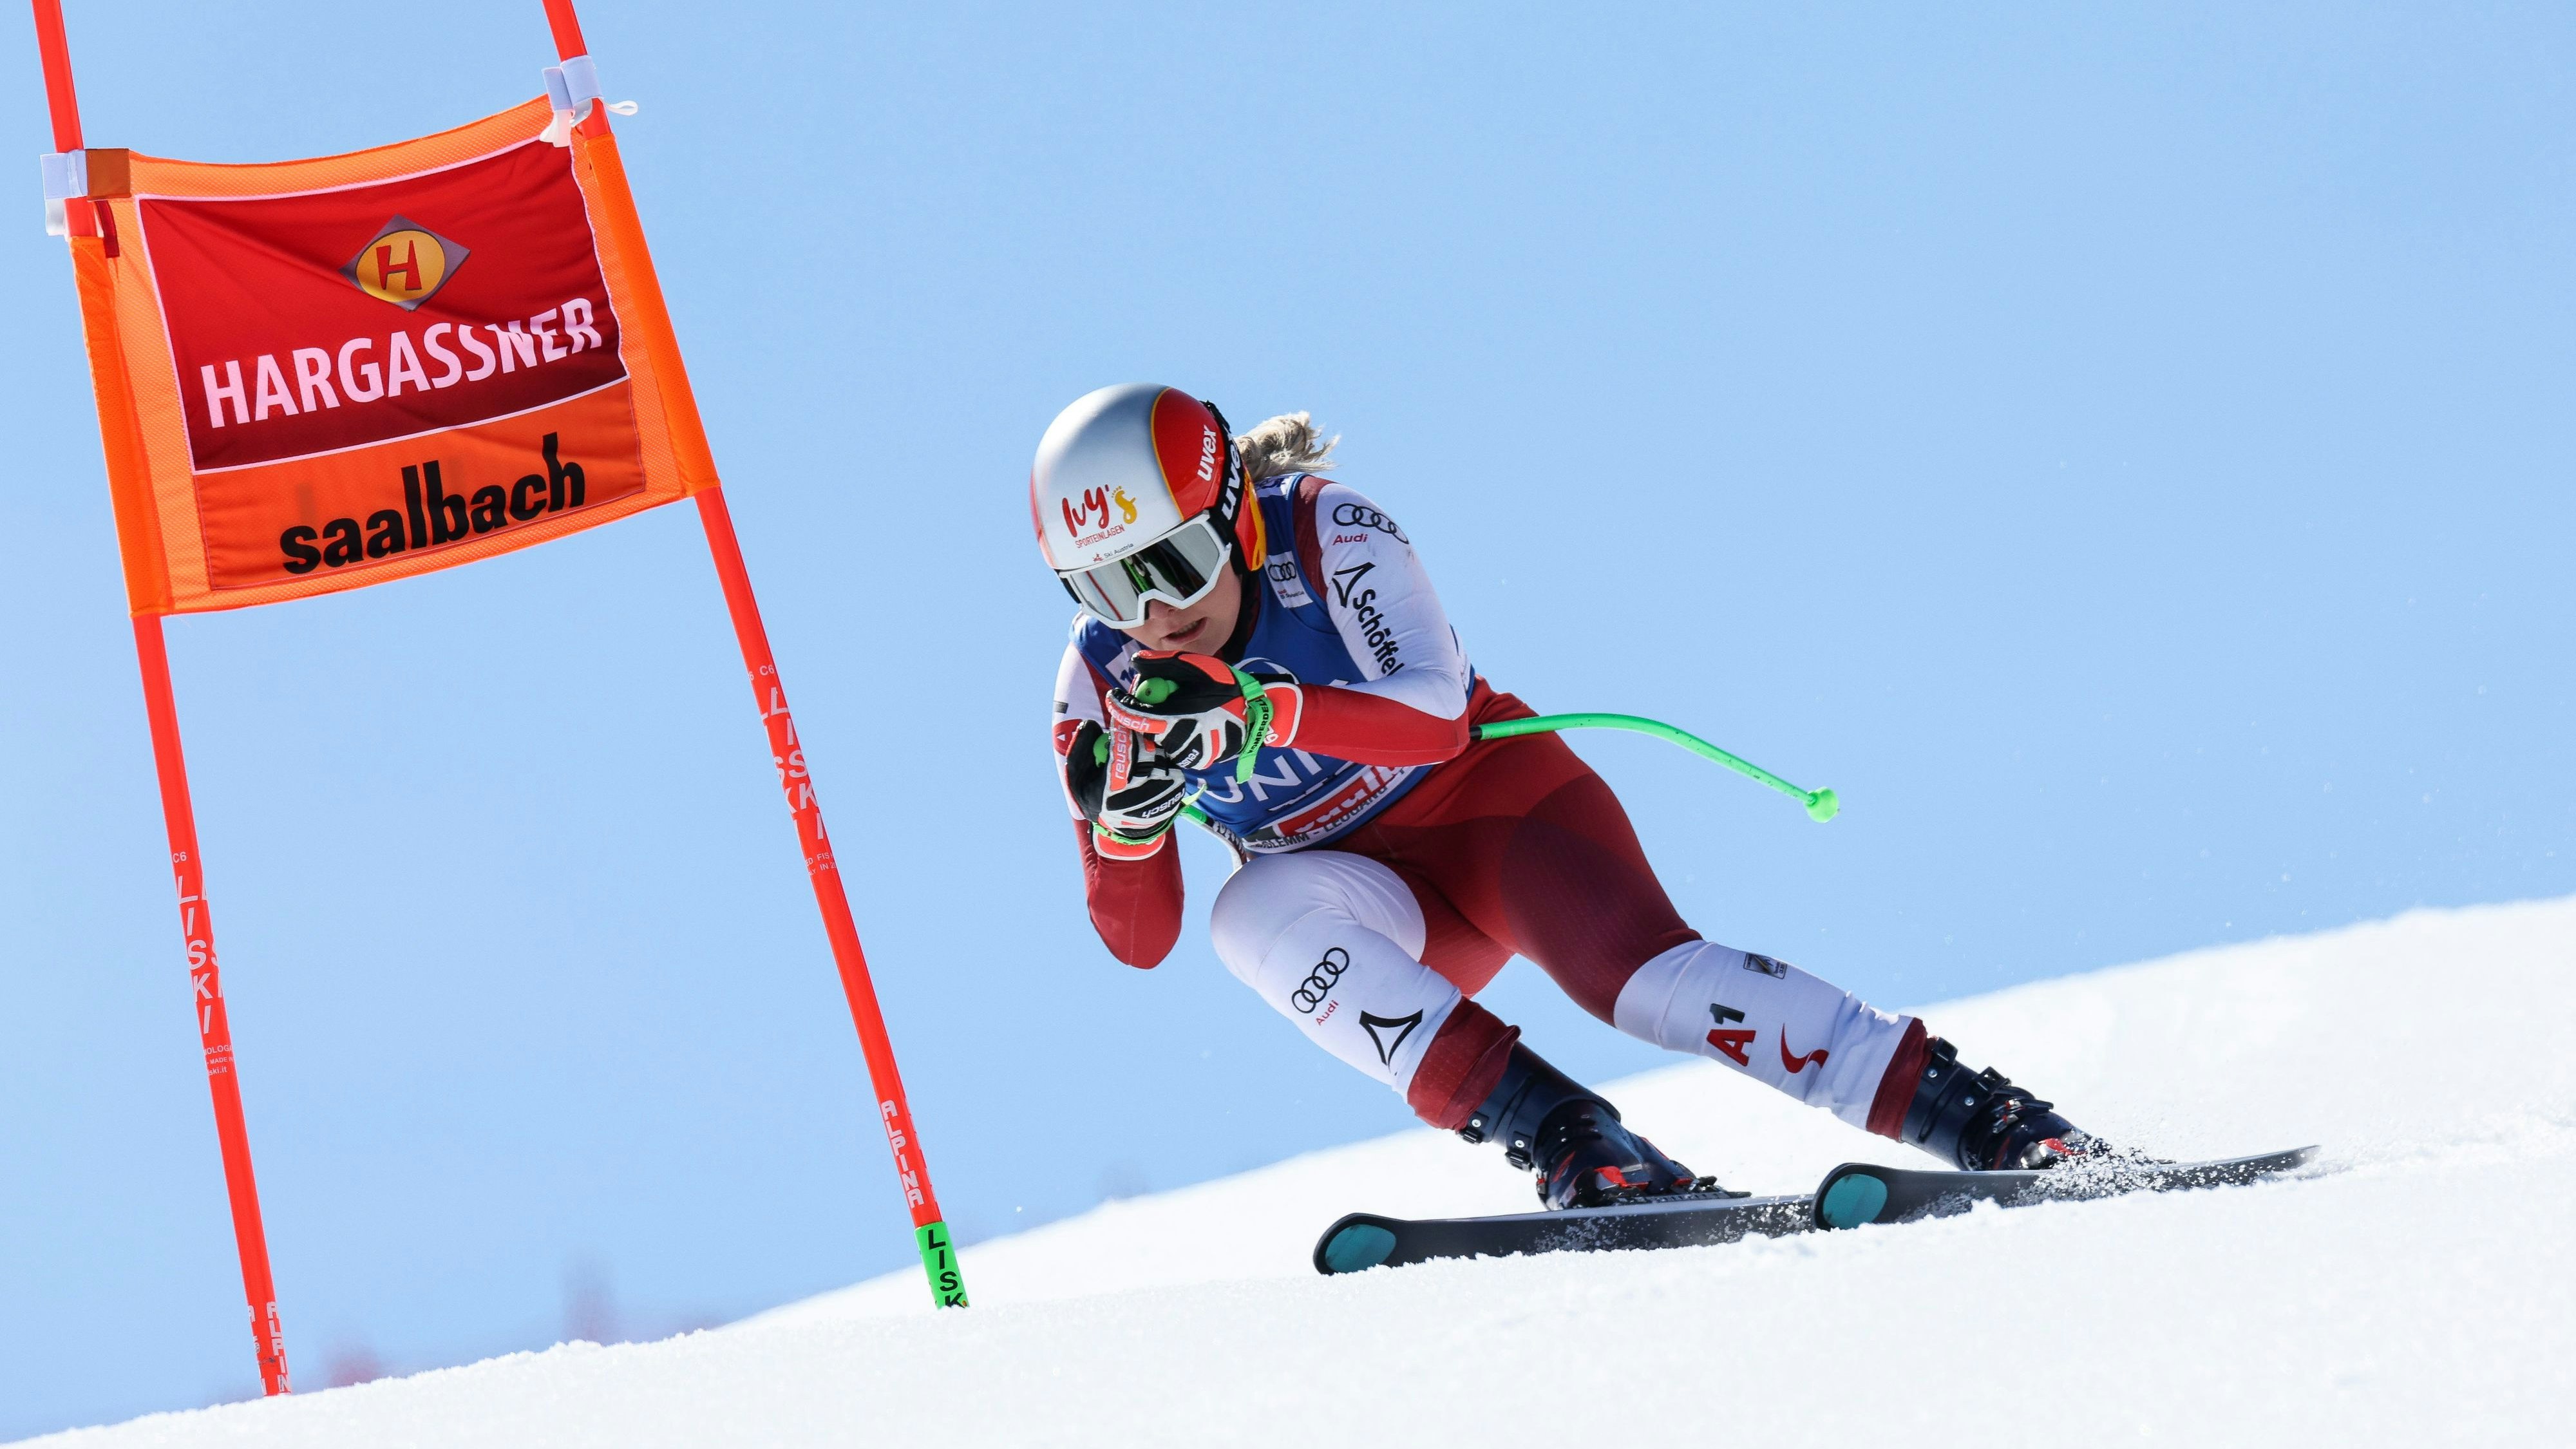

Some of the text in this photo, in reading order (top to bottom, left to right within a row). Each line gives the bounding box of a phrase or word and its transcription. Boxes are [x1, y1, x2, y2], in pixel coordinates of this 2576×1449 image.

[376, 240, 422, 290] H
[200, 297, 603, 429] HARGASSNER
[1197, 425, 1217, 481] uvex
[1222, 435, 1241, 520] uve
[279, 431, 587, 575] saalbach
[1075, 524, 1125, 548] SPORTEINLAGEN
[1114, 544, 1133, 554] Austria
[1332, 533, 1368, 545] Audi
[759, 665, 775, 676] C6
[770, 687, 824, 840] LISKI
[1176, 748, 1200, 768] reusc
[1197, 748, 1323, 803] UNI
[1141, 788, 1185, 819] reusch
[173, 851, 187, 863] C6
[817, 852, 829, 861] FIS
[176, 875, 213, 1034] LISKI
[1316, 999, 1339, 1027] Audi
[1706, 1003, 1756, 1066] A1
[208, 1066, 227, 1075] ski.it
[881, 1099, 925, 1209] ALPINA
[928, 1229, 965, 1308] LISK
[267, 1301, 292, 1393] ALPIN
